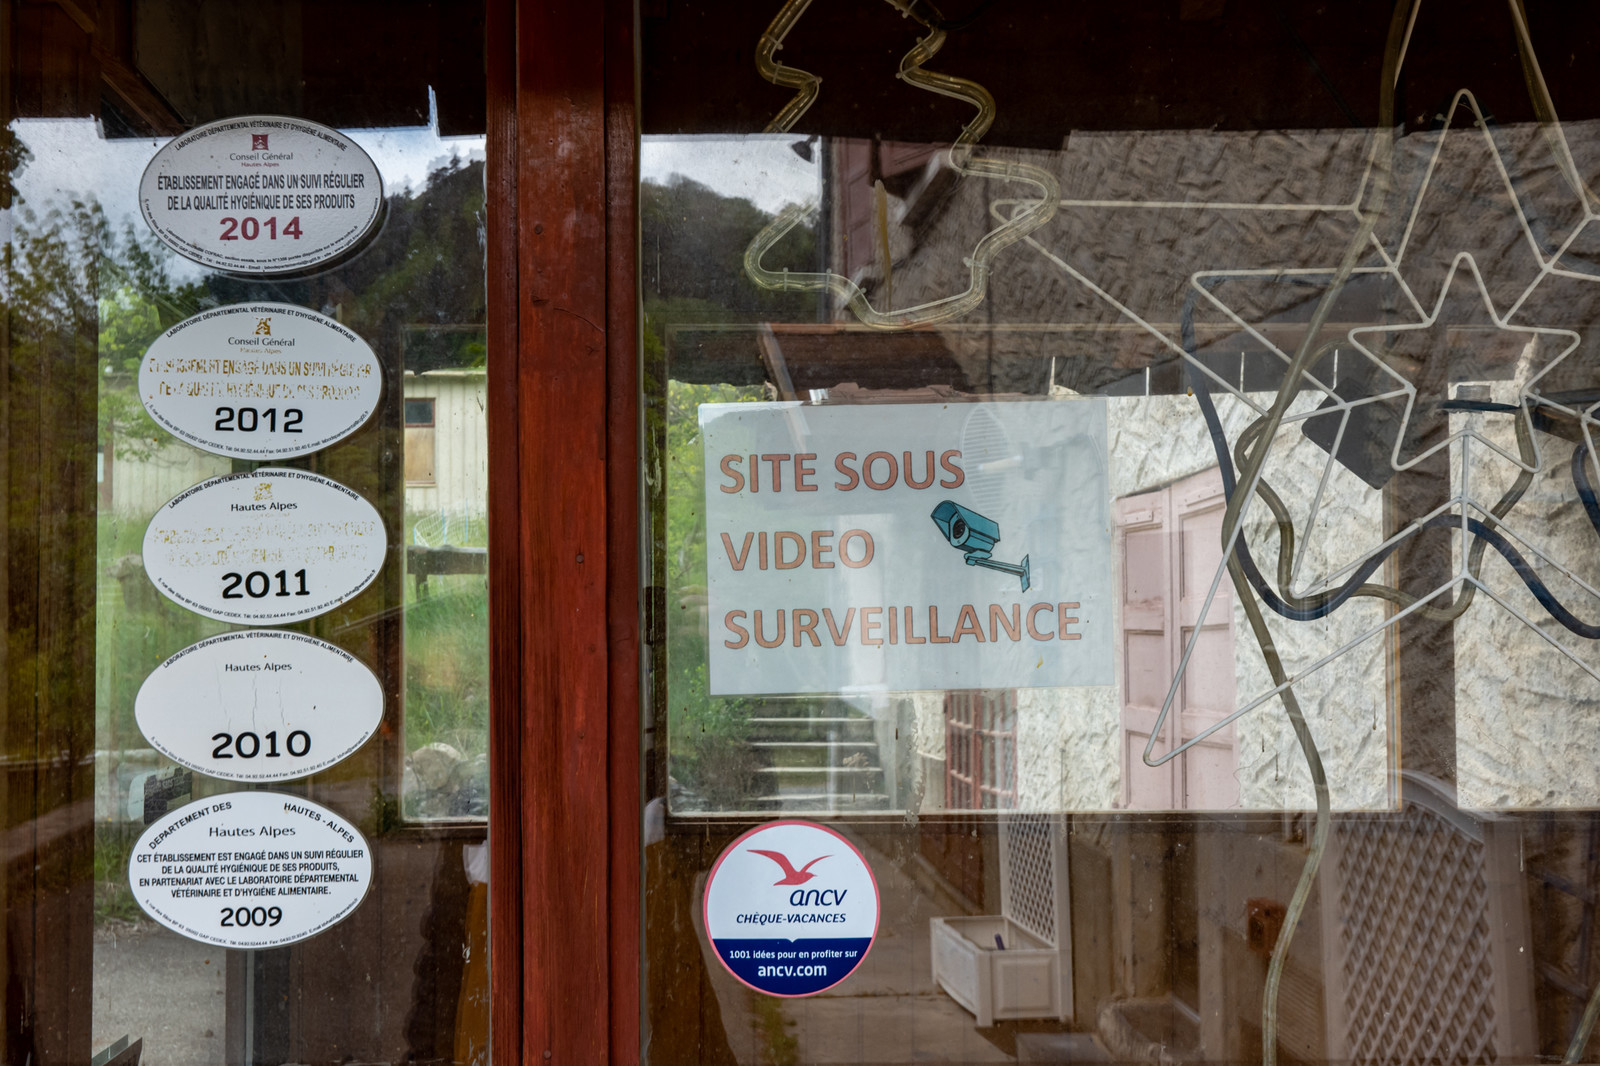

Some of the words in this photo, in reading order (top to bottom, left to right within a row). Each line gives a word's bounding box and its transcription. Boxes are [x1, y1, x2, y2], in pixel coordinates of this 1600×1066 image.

[174, 130, 208, 151] LABORATOIRE
[207, 121, 249, 136] DÉPARTEMENTAL
[283, 122, 290, 130] ET
[317, 131, 348, 152] ALIMENTAIRE
[229, 152, 259, 161] Conseil
[261, 151, 293, 161] Général
[157, 172, 224, 190] ÉTABLISSEMENT
[225, 171, 260, 190] ENGAGÉ
[262, 174, 285, 189] DANS
[286, 174, 299, 189] UN
[300, 174, 322, 189] SUIVI
[323, 170, 365, 188] RÉGULIER
[167, 195, 179, 211] DE
[181, 195, 192, 210] LA
[193, 192, 228, 211] QUALITÉ
[231, 192, 281, 210] HYGIÉNIQUE
[282, 195, 294, 210] DE
[296, 194, 312, 209] SES
[314, 194, 355, 209] PRODUITS
[219, 216, 303, 241] 2014
[166, 316, 202, 338] LABORATOIRE
[202, 307, 249, 320] DÉPARTEMENTAL
[250, 306, 286, 315] VÉTÉRINAIRE
[323, 320, 357, 343] ALIMENTAIRE
[228, 336, 260, 345] Conseil
[261, 337, 295, 346] Général
[288, 361, 301, 376] UN
[215, 406, 304, 433] 2012
[197, 437, 209, 445] GAP
[719, 453, 819, 494] SITE
[834, 449, 966, 492] SOUS
[168, 485, 204, 509] LABORATOIRE
[203, 472, 250, 489] DÉPARTEMENTAL
[251, 470, 287, 478] VÉTÉRINAIRE
[288, 471, 296, 479] ET
[325, 480, 360, 502] ALIMENTAIRE
[230, 503, 266, 512] Hautes
[269, 501, 298, 512] Alpes
[720, 528, 875, 571] VIDEO
[221, 568, 310, 600] 2011
[724, 601, 1083, 650] SURVEILLANCE
[163, 645, 199, 668] LABORATOIRE
[198, 633, 245, 649] DÉPARTEMENTAL
[246, 631, 282, 639] VÉTÉRINAIRE
[320, 642, 354, 663] ALIMENTAIRE
[225, 663, 261, 672] Hautes
[263, 662, 292, 672] Alpes
[211, 730, 312, 759] 2010
[148, 806, 210, 850] DEPARTEMENT
[212, 801, 233, 813] DES
[283, 802, 322, 821] HAUTES
[326, 820, 355, 843] ALPES
[209, 827, 255, 837] Hautes
[259, 825, 296, 838] Alpes
[136, 854, 152, 863] CET
[153, 851, 216, 862] ÉTABLISSEMENT
[217, 852, 232, 861] EST
[234, 850, 266, 861] ENGAGÉ
[268, 851, 289, 860] DANS
[291, 850, 302, 860] UN
[304, 850, 324, 859] SUIVI
[325, 848, 364, 859] RÉGULIER
[161, 865, 173, 875] DE
[174, 865, 184, 874] LA
[185, 863, 218, 874] QUALITÉ
[220, 862, 267, 873] HYGIÉNIQUE
[269, 863, 280, 872] DE
[282, 863, 297, 872] SES
[298, 862, 340, 872] PRODUITS,
[139, 878, 150, 887] EN
[151, 877, 203, 886] PARTENARIAT
[204, 877, 226, 885] AVEC
[227, 876, 237, 885] LE
[238, 875, 292, 885] LABORATOIRE
[294, 873, 359, 884] DÉPARTEMENTAL
[171, 887, 221, 898] VÉTÉRINAIRE
[223, 888, 233, 897] ET
[277, 886, 332, 896] ALIMENTAIRE.
[789, 889, 848, 907] ancv
[220, 906, 283, 927] 2009
[736, 911, 847, 926] CHÈQUE-VACANCES
[729, 950, 751, 959] 1001
[753, 949, 776, 959] idées
[777, 951, 797, 961] pour
[798, 951, 810, 959] en
[811, 949, 843, 960] profiter
[844, 950, 858, 958] sur
[757, 965, 827, 977] ancv.com
